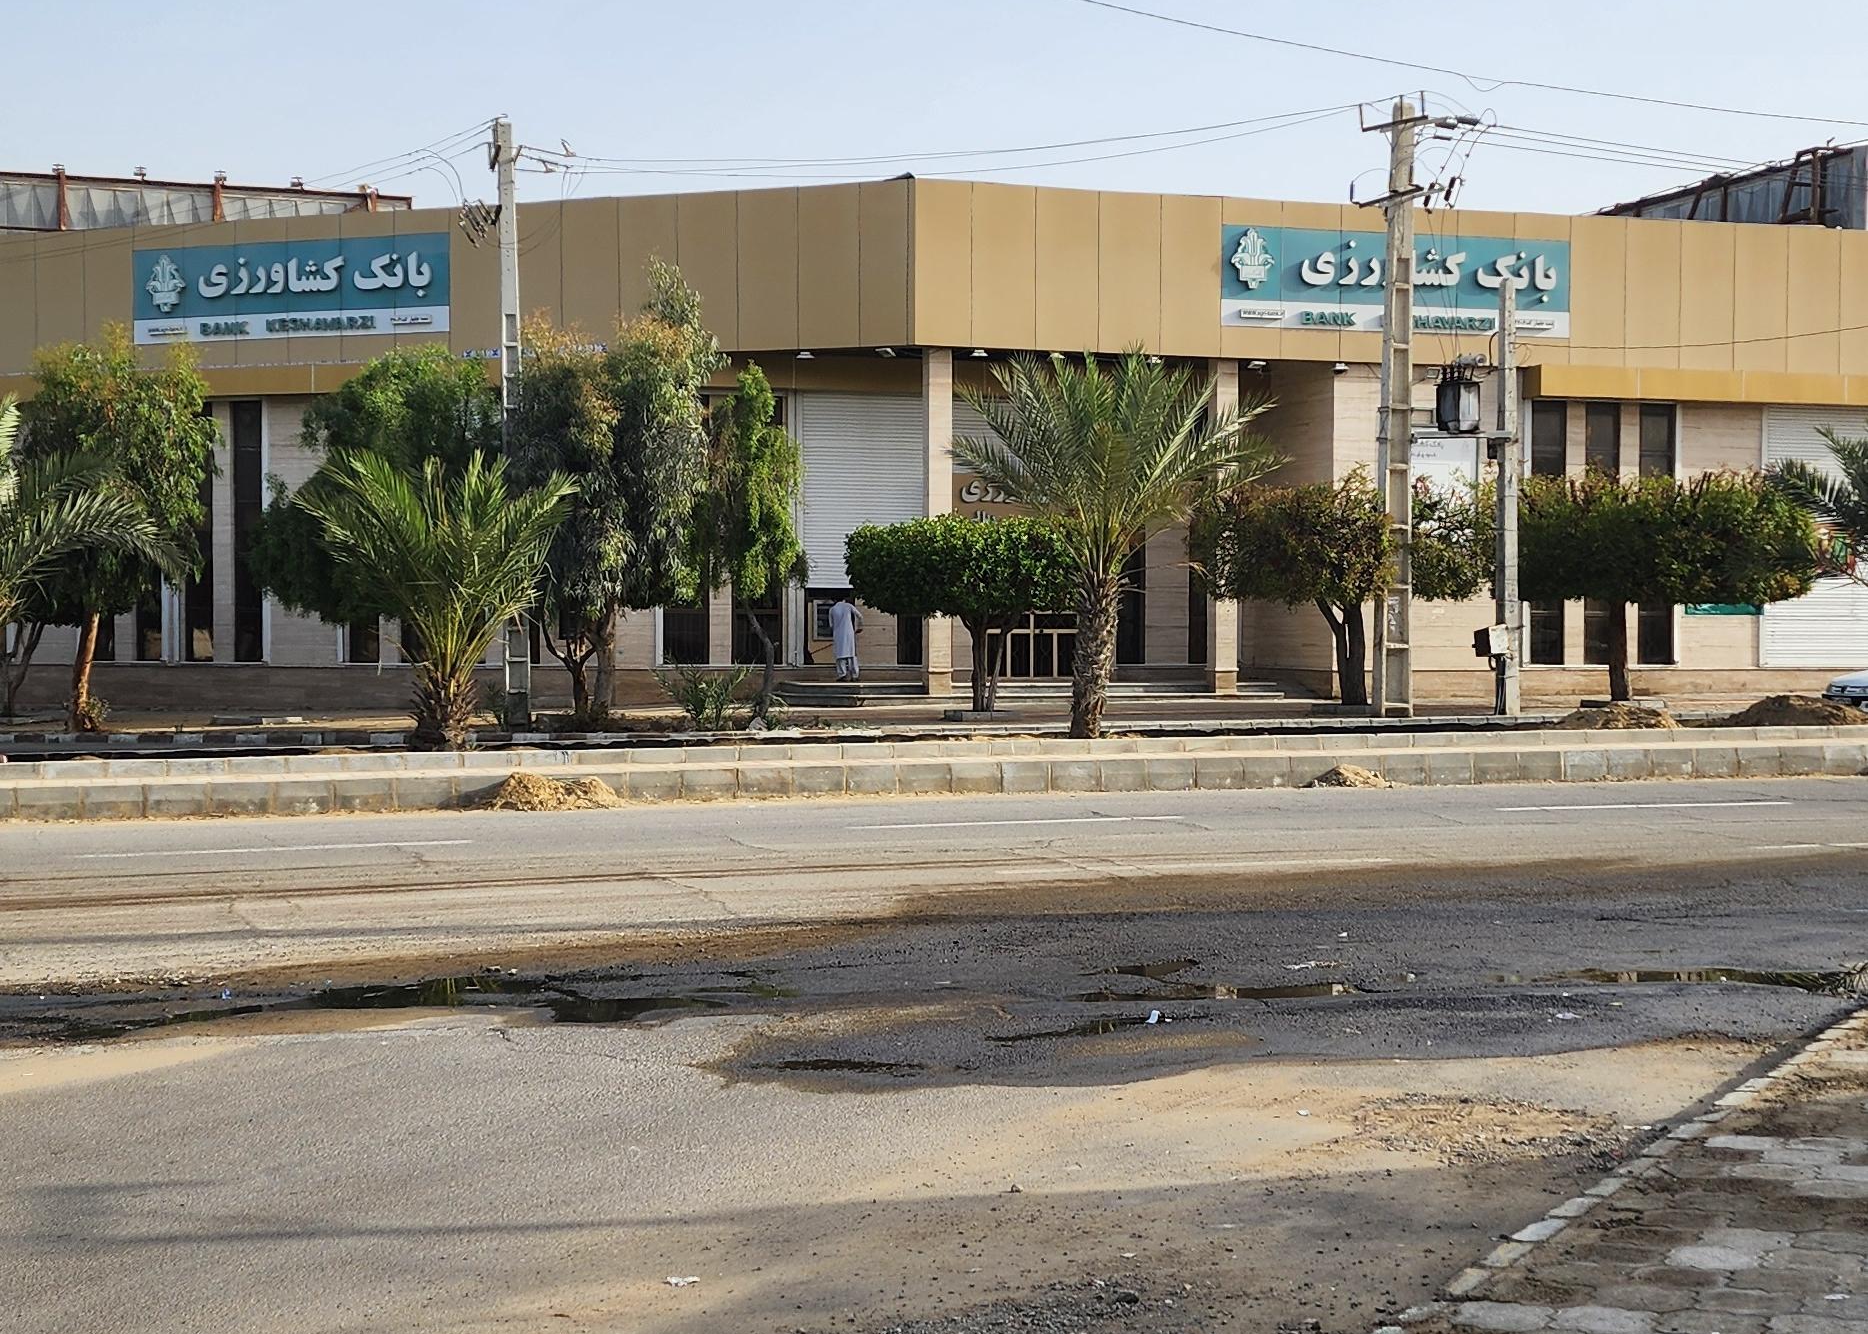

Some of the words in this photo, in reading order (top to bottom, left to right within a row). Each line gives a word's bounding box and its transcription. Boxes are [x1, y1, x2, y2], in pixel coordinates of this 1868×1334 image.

[198, 254, 345, 299] کشاورزی
[353, 250, 432, 298] بانک
[1475, 250, 1557, 304] بانک
[200, 321, 250, 336] BANK
[265, 315, 377, 333] KESHAVARZI
[1300, 310, 1357, 327] BANK
[1412, 315, 1496, 331] HAVARZI
